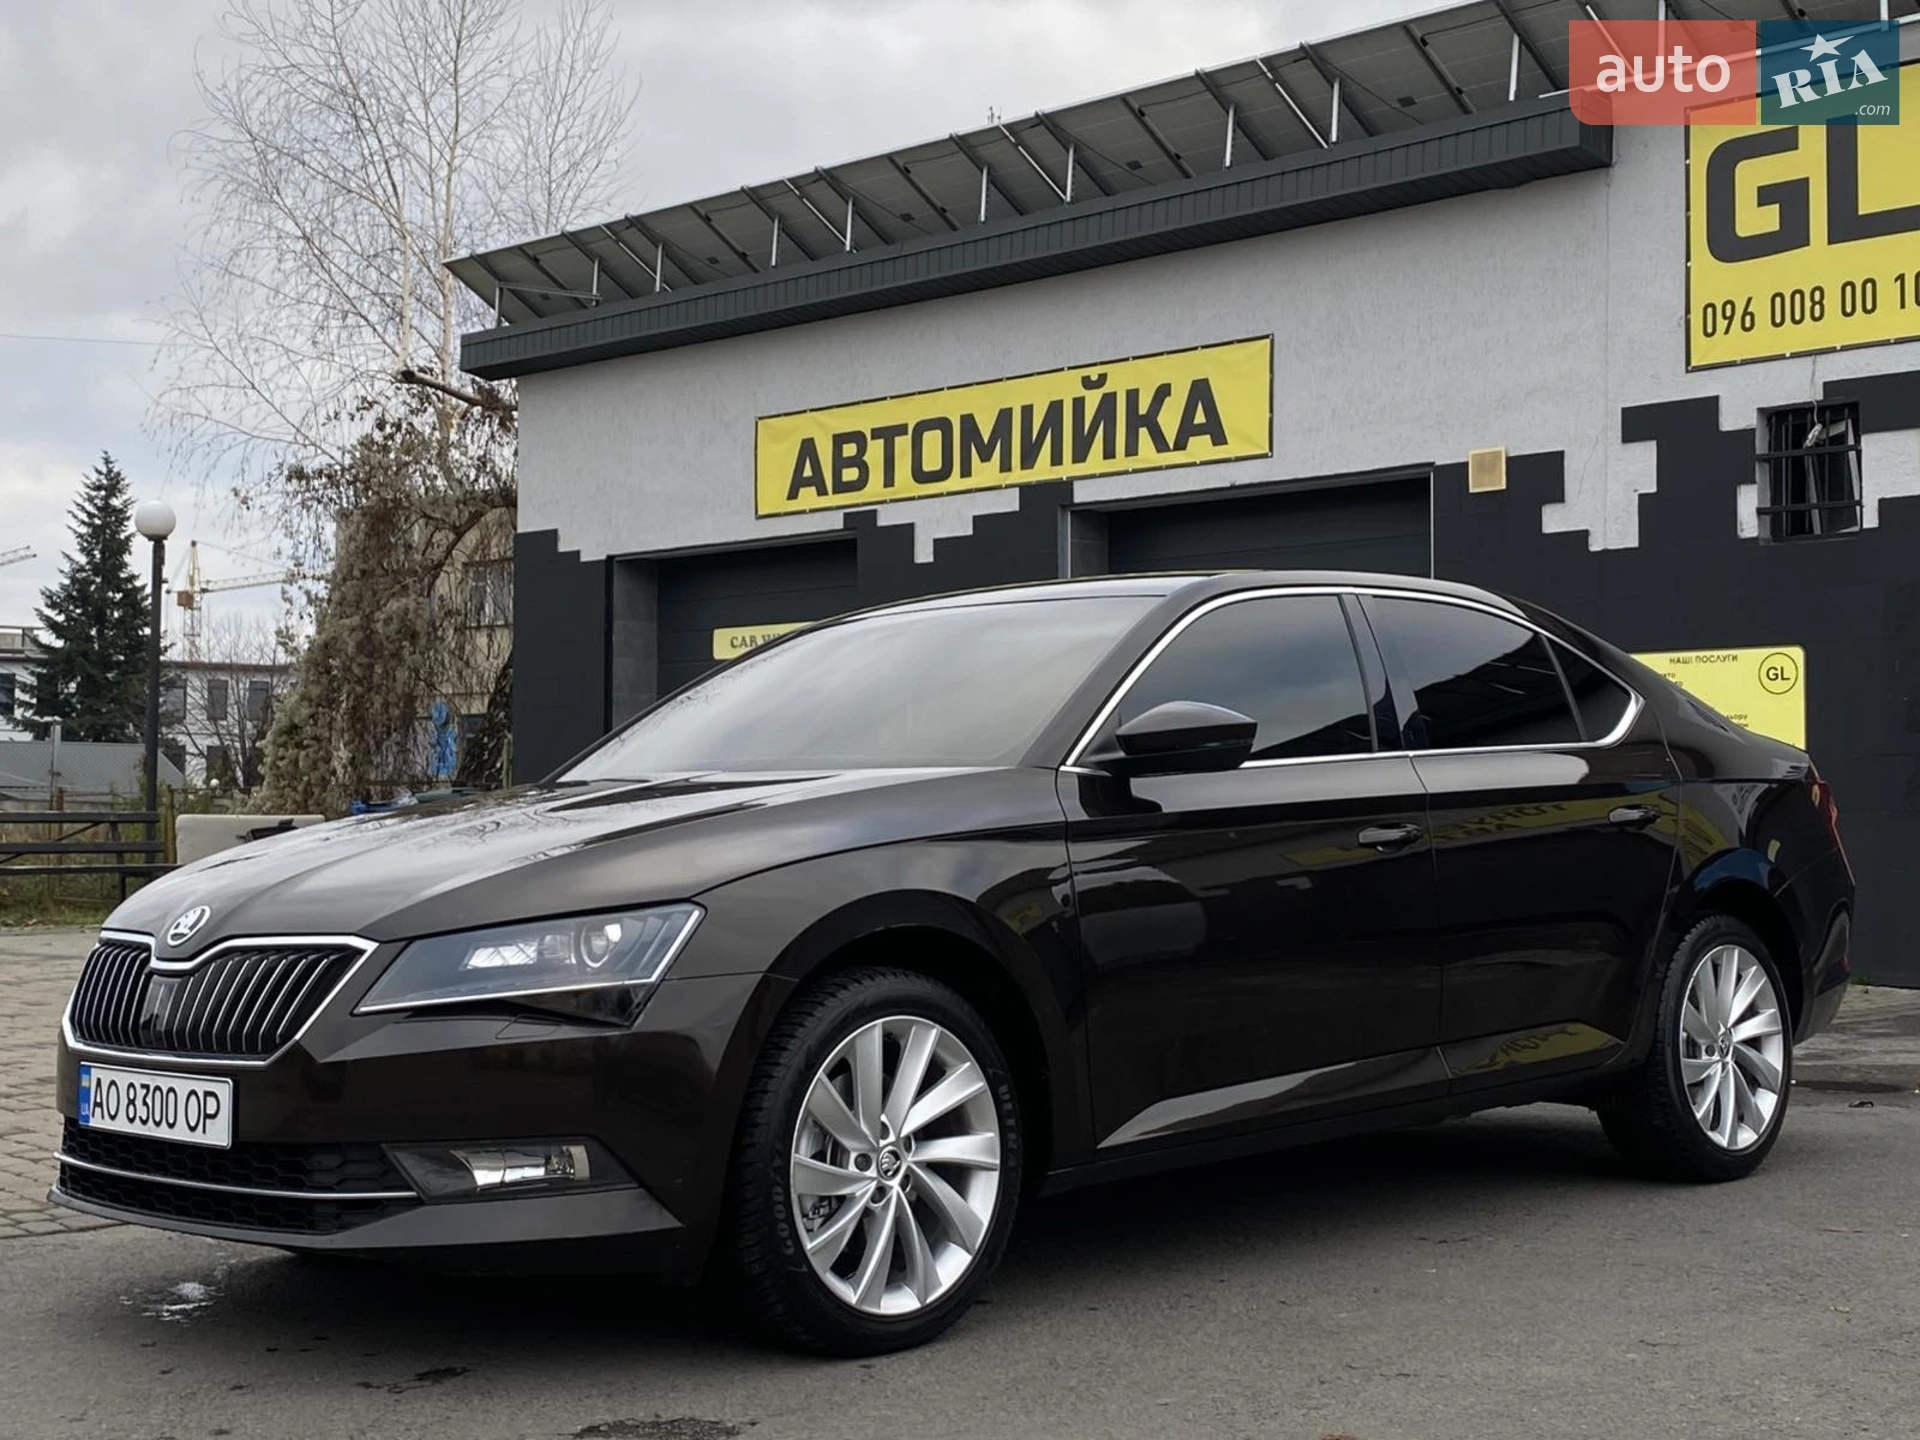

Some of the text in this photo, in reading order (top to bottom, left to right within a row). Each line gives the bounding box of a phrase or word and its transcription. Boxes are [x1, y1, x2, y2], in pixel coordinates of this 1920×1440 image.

[1702, 295, 1756, 338] 096
[1769, 285, 1825, 329] 008
[1840, 277, 1878, 318] 00
[785, 371, 1230, 502] АВТОМИЙКА
[730, 634, 759, 649] CAR
[1669, 654, 1739, 665] НАШІ ПОСЛУГИ
[1765, 666, 1791, 682] GL
[91, 1077, 221, 1135] AO 8300 OP
